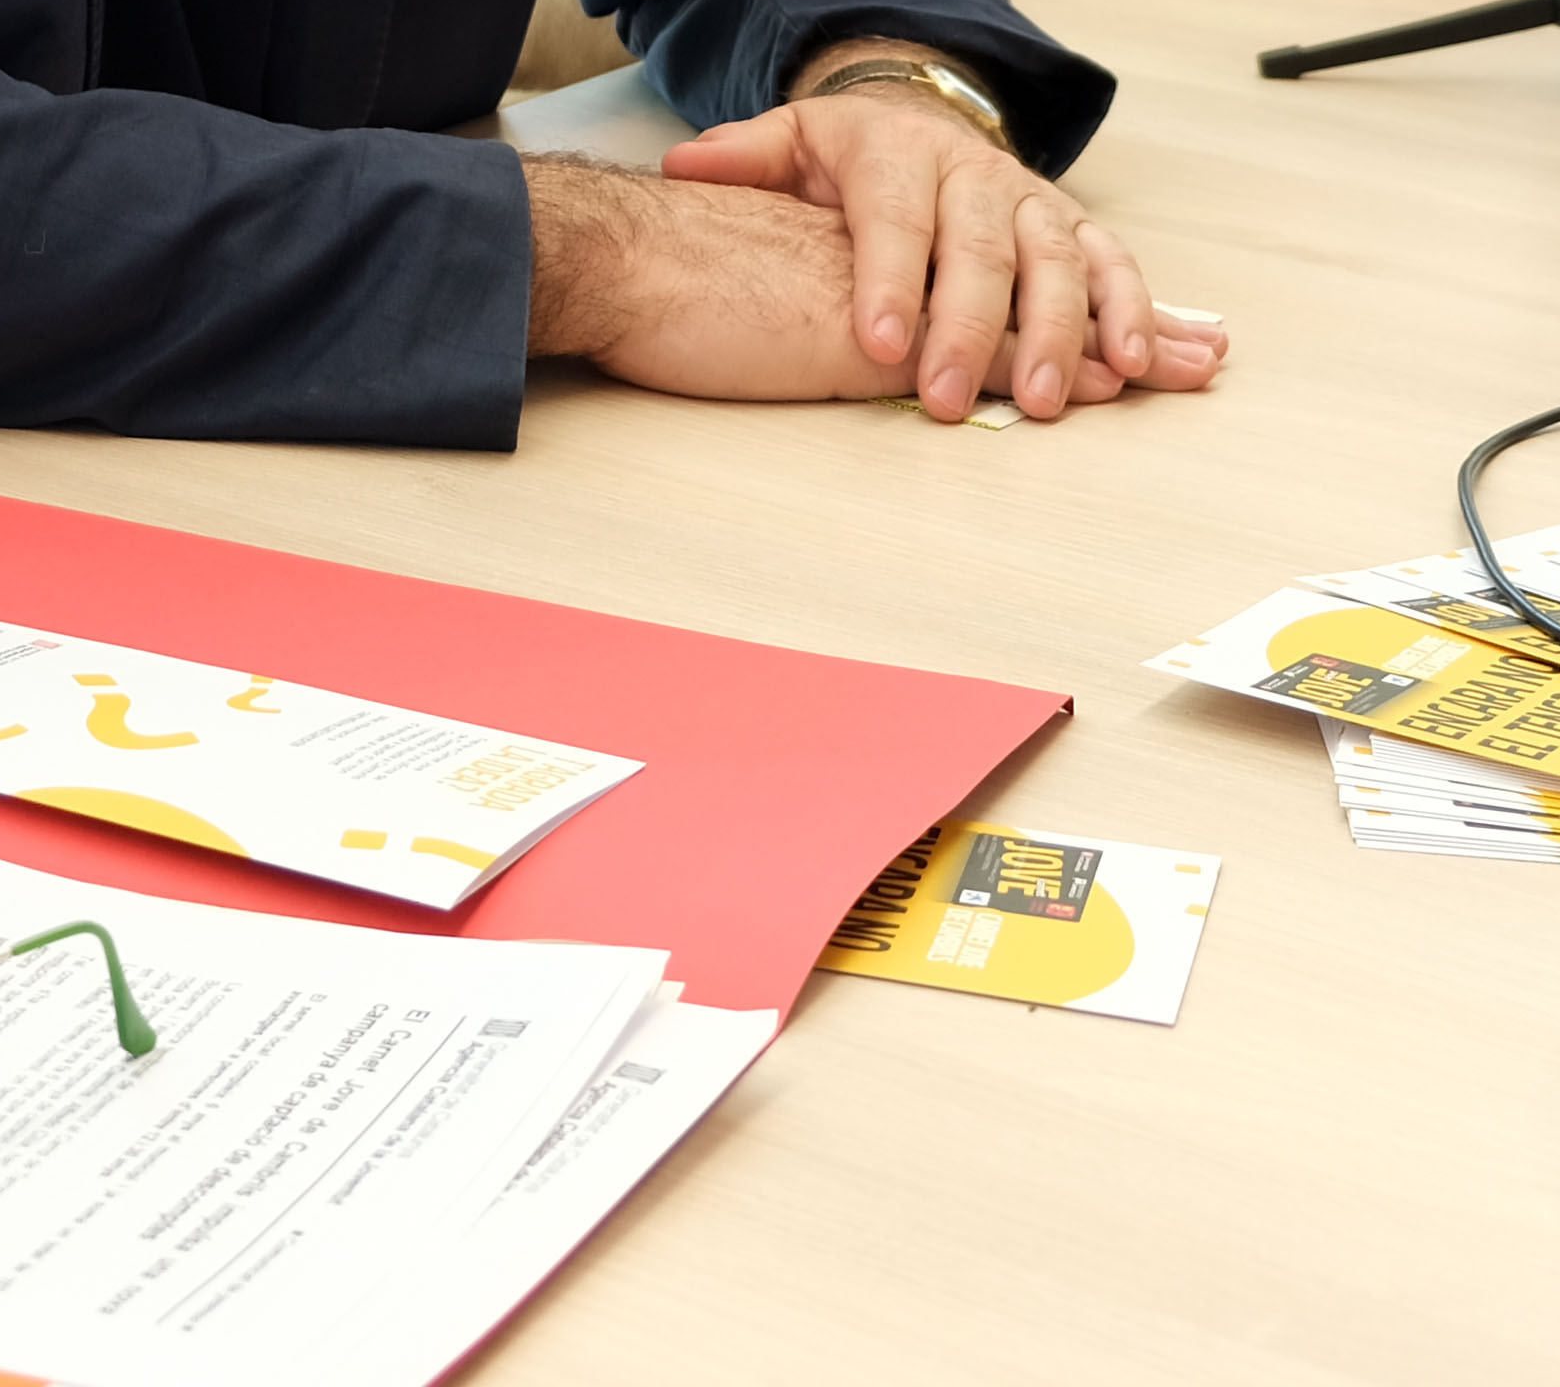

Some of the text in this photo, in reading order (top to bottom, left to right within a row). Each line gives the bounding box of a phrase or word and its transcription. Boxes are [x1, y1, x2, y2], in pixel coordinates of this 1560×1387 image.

[1288, 667, 1374, 708] JOVE
[1397, 679, 1525, 740] ENCARA
[1478, 733, 1560, 761] EL
[997, 839, 1064, 899] JOVE
[403, 1009, 430, 1023] El
[357, 1029, 411, 1072] Carnet
[321, 1079, 363, 1111] Jove
[140, 1003, 388, 1240] campanya de captació de descomptes
[299, 1117, 326, 1134] de
[236, 1141, 307, 1196] Cambrils
